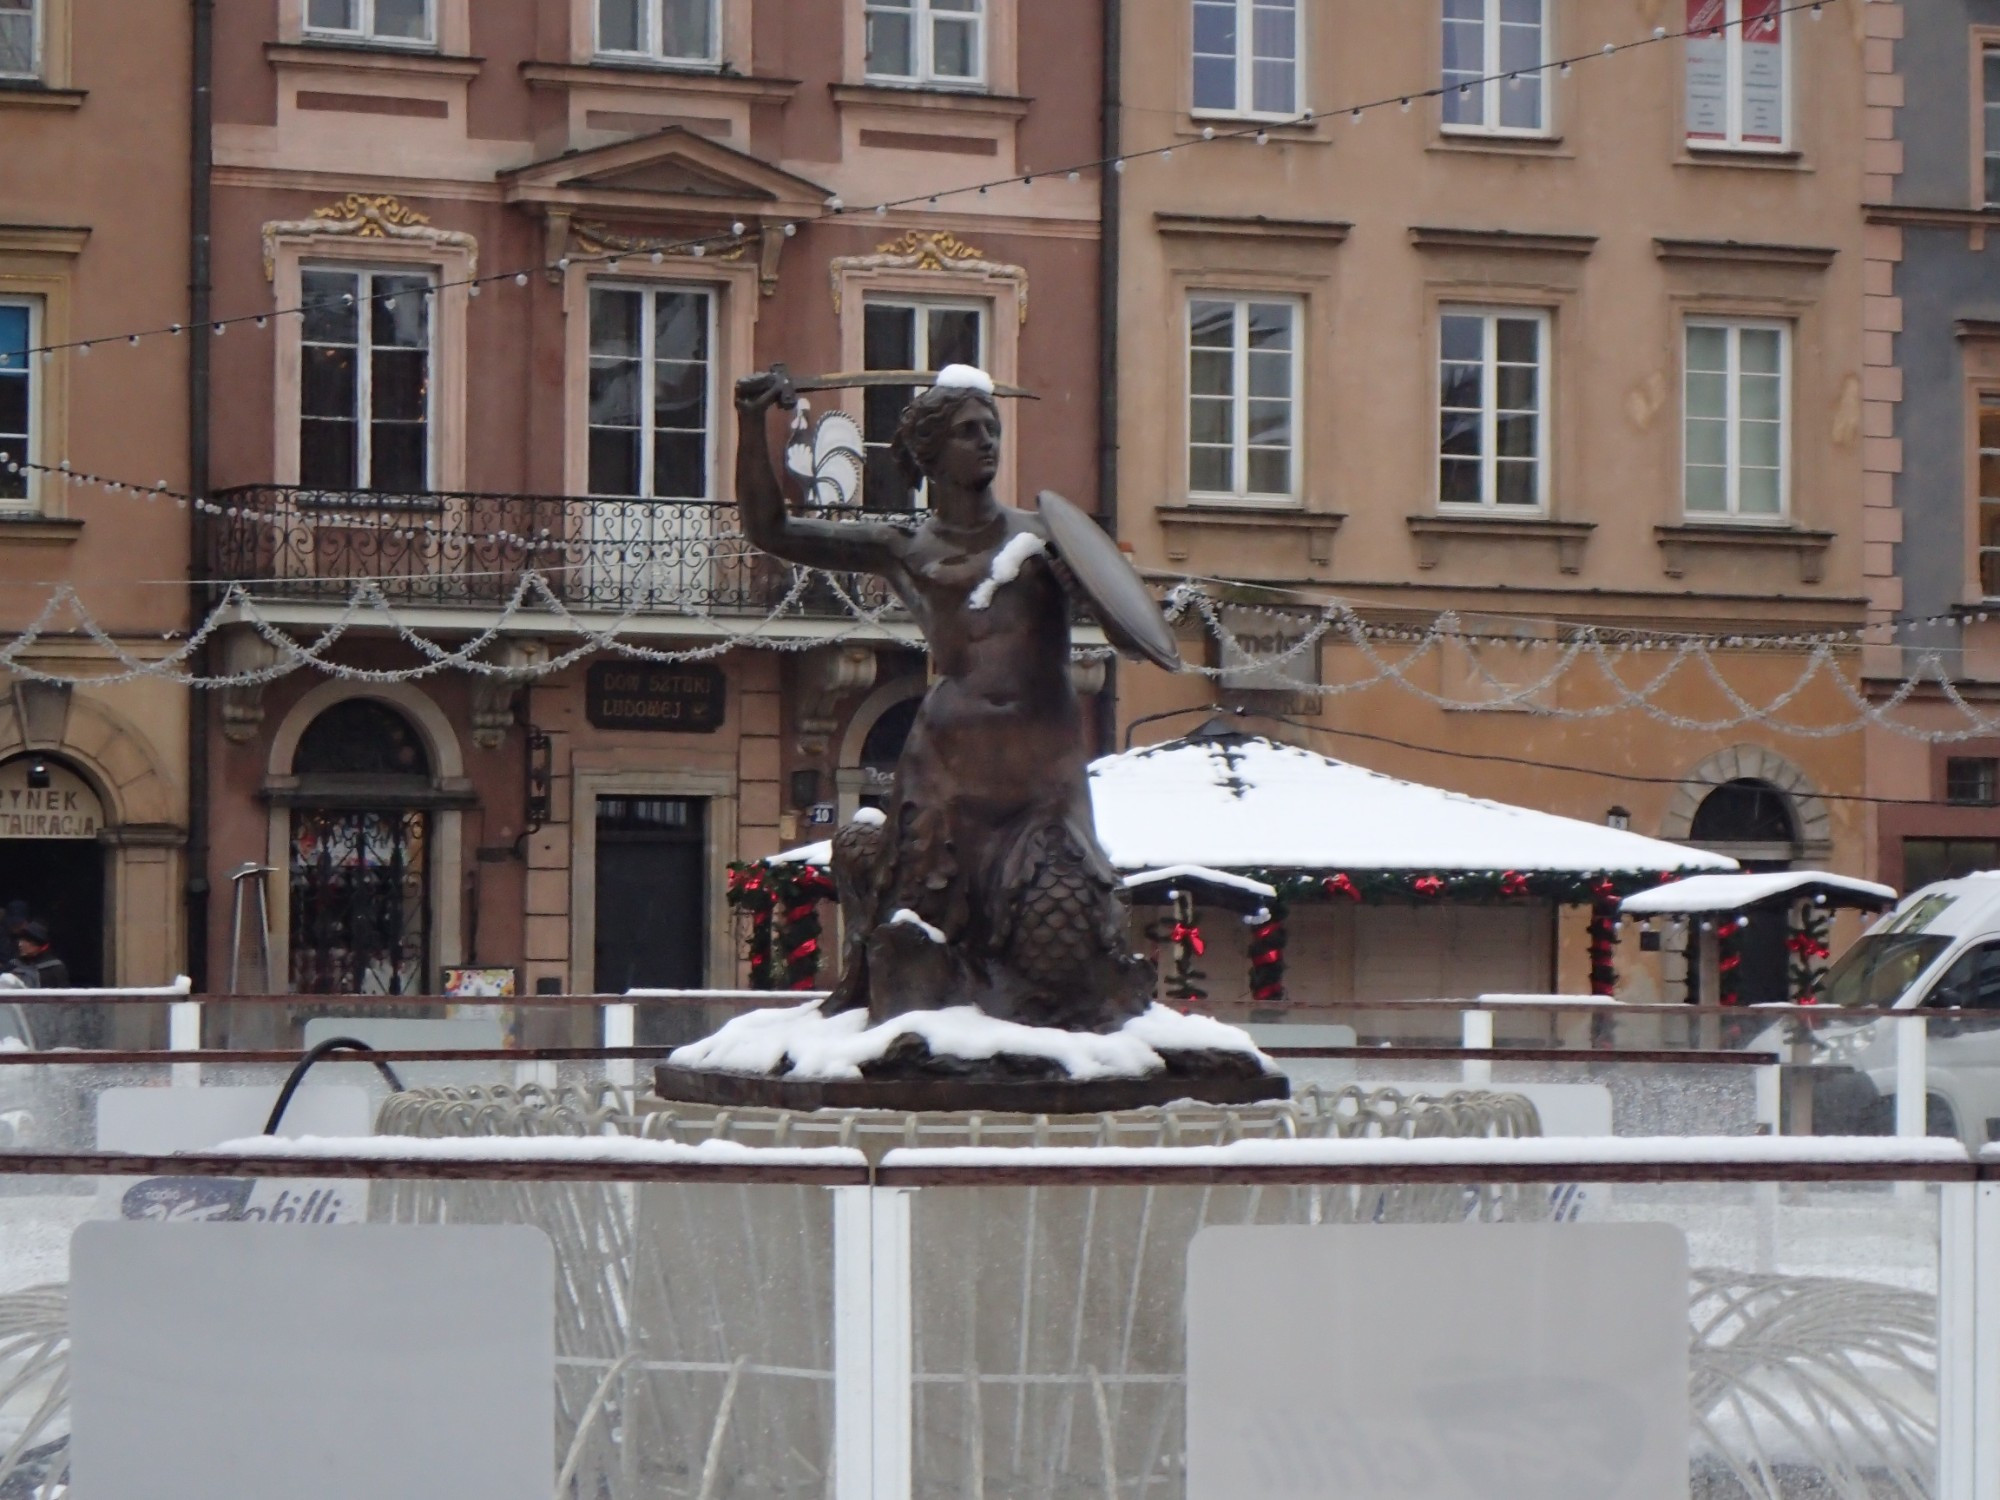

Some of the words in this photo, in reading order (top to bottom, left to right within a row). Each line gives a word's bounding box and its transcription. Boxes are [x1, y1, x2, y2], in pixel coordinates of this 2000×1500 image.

[649, 674, 711, 694] SZTUKI
[602, 699, 682, 718] LUDOWEJ
[0, 789, 79, 811] YNEK
[815, 808, 830, 823] 10
